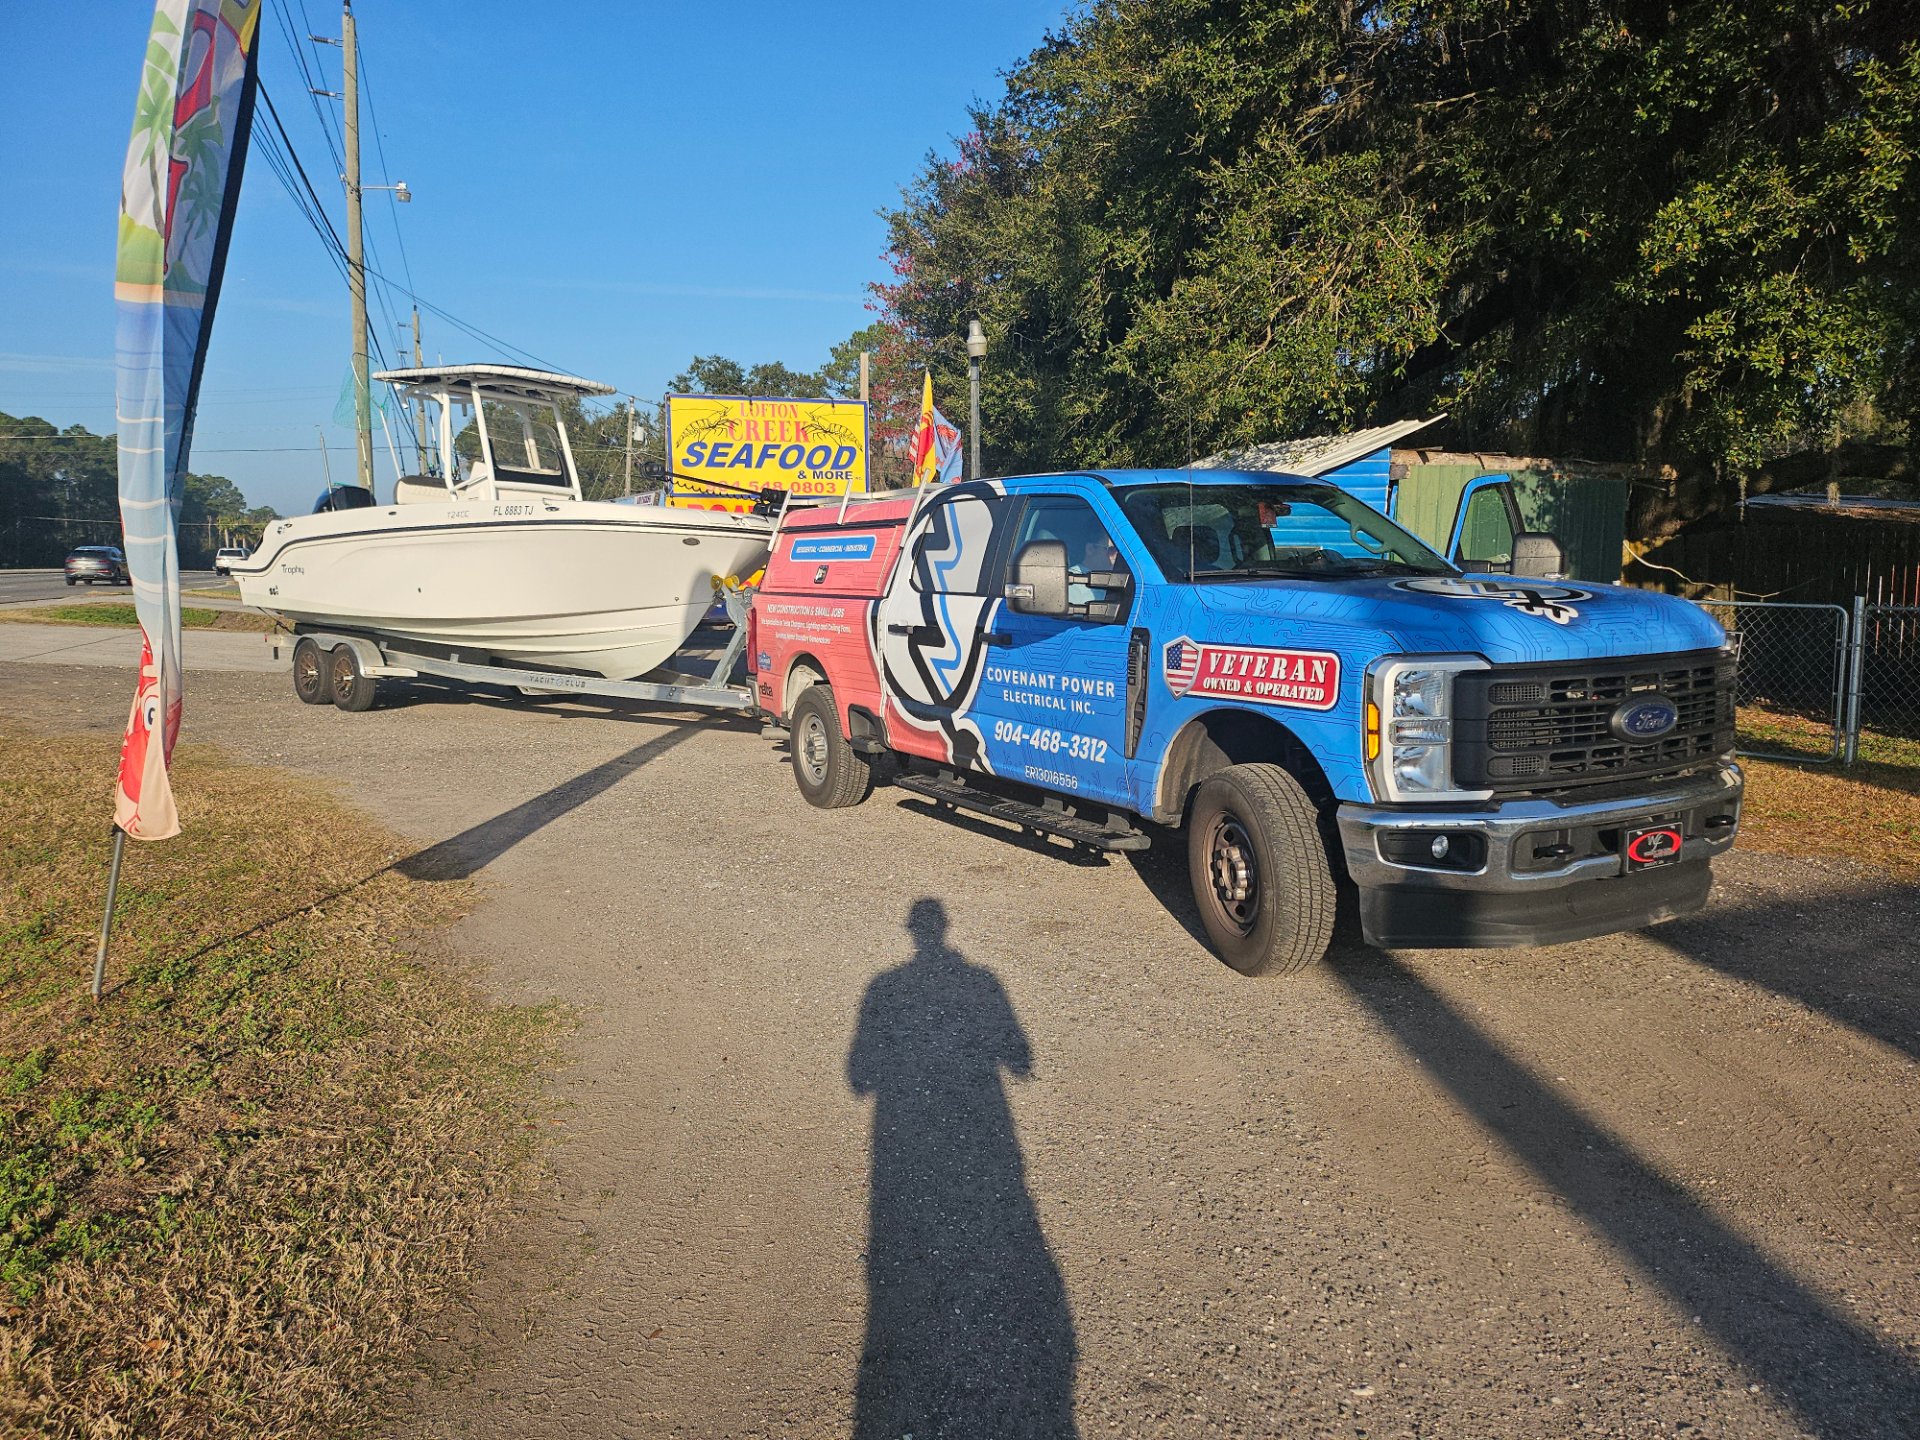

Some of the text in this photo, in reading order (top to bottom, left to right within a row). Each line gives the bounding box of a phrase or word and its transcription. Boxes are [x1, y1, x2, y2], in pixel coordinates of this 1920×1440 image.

[740, 402, 798, 419] LOFTON
[727, 418, 811, 443] CREEK
[681, 442, 857, 470] SEAFOOD
[797, 470, 808, 480] &
[812, 470, 853, 480] MORE
[791, 482, 836, 494] 0803
[493, 505, 502, 516] FL
[524, 505, 534, 516] TJ
[281, 564, 305, 575] Trophy
[815, 607, 830, 616] SMALL
[831, 607, 845, 618] JOBS
[1209, 652, 1328, 684] VETERAN
[529, 675, 586, 688] YACHT CLUB
[987, 667, 1115, 698] COVENANT POWER
[1203, 677, 1325, 702] OWNED & OPERATED
[1003, 689, 1095, 715] ELECTRICAL INC.
[1636, 711, 1668, 731] Ford
[994, 720, 1108, 764] 904-468-3312
